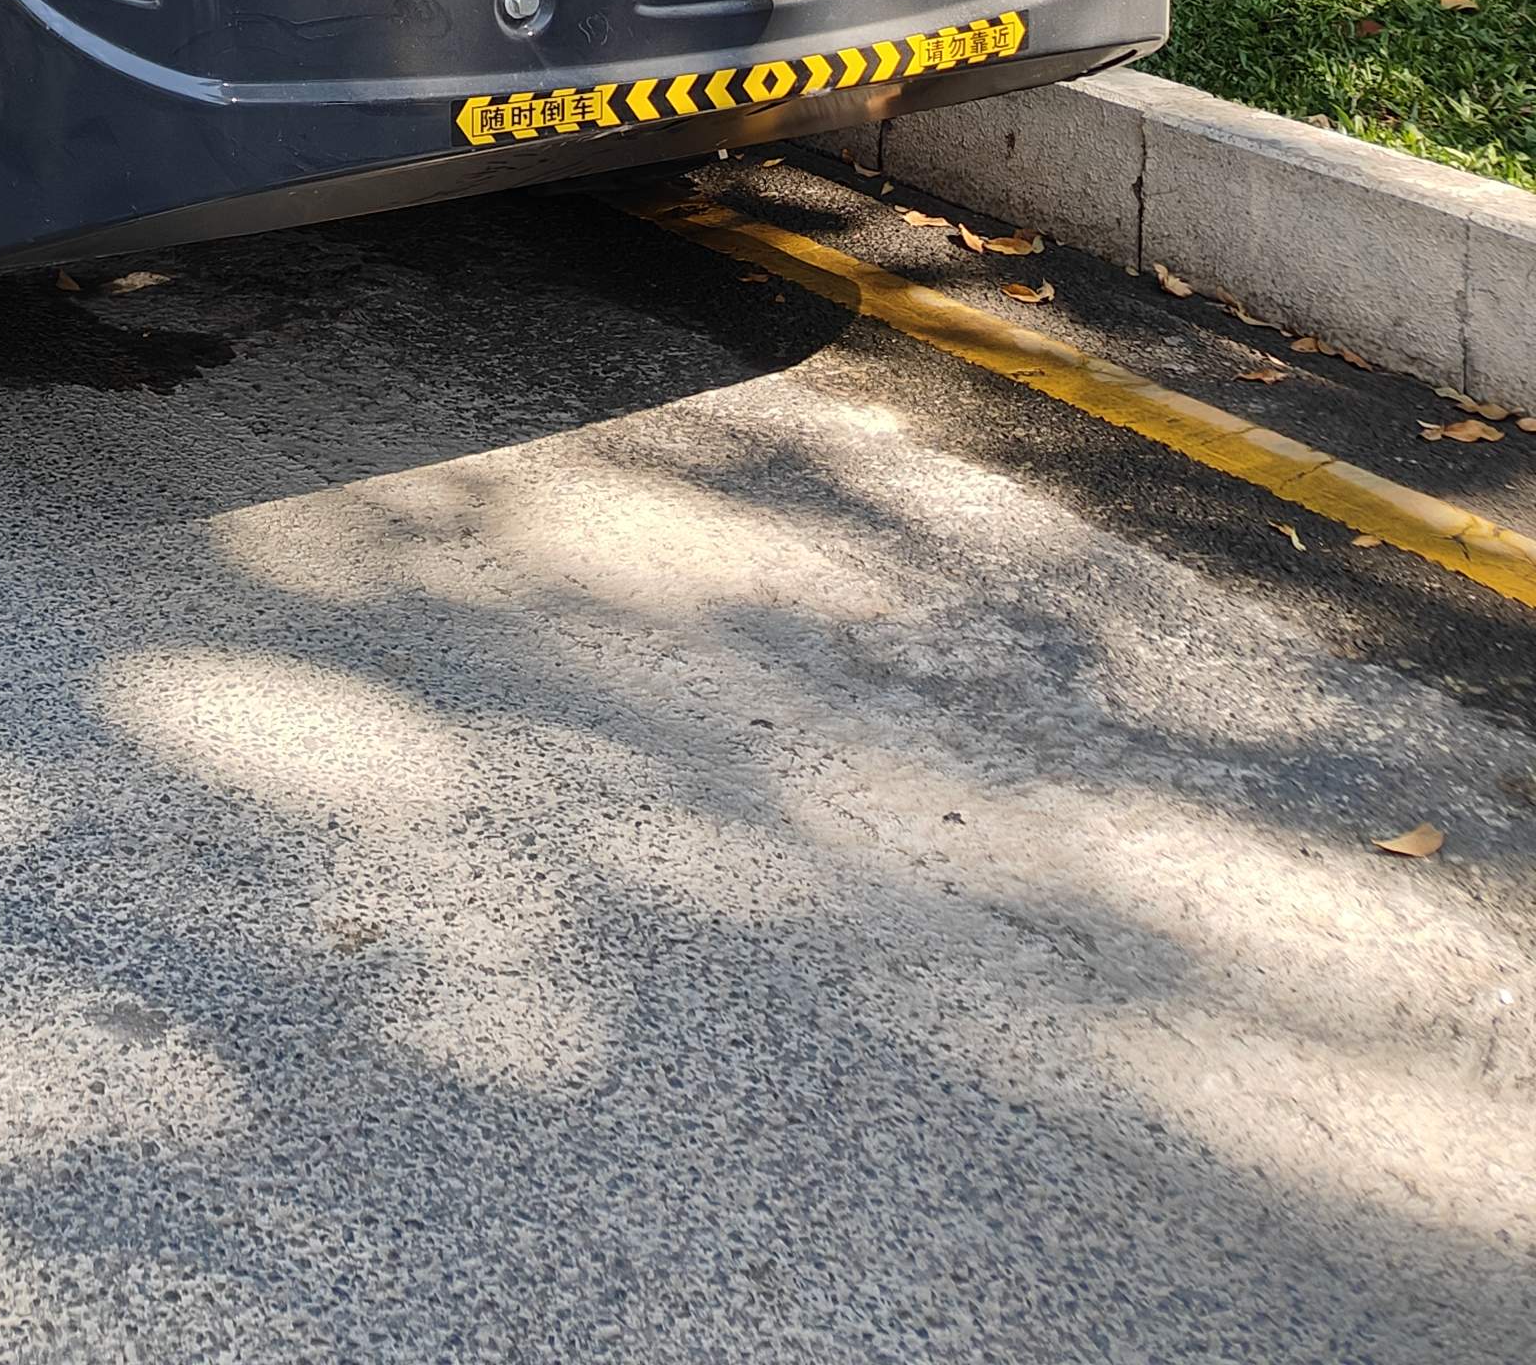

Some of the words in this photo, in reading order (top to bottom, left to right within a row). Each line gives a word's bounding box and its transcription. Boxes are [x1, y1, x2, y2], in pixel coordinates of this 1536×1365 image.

[925, 23, 1012, 64] 请勿靠近
[478, 93, 598, 133] 随时倒车
